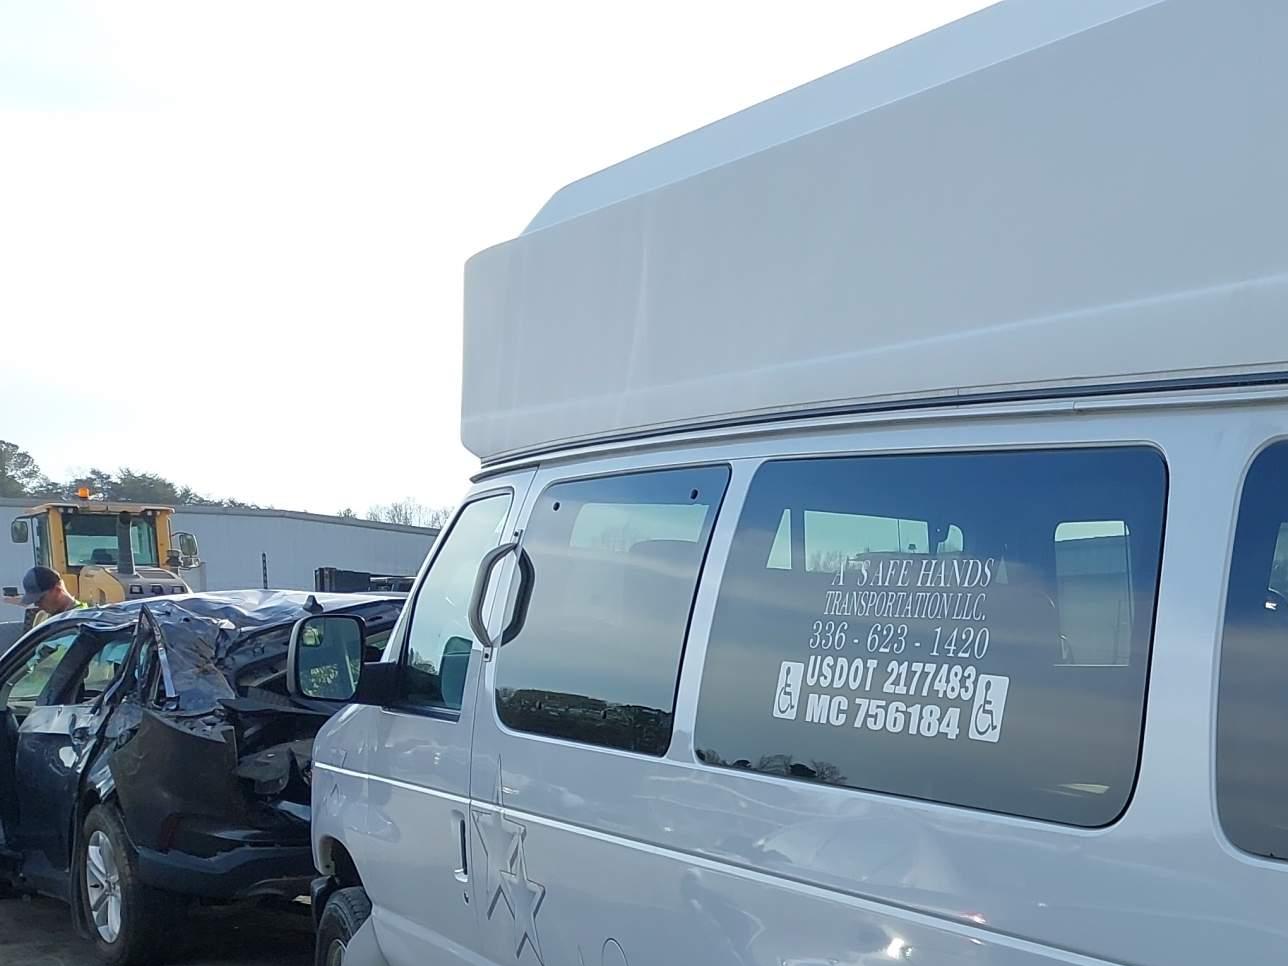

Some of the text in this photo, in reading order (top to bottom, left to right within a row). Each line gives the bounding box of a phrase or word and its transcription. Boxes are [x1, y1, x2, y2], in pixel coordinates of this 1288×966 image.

[831, 558, 994, 588] A SAFE HANDS
[824, 591, 986, 621] TRANSPORTATION LLC.
[809, 620, 848, 650] 336
[866, 623, 908, 654] 623
[930, 626, 990, 659] 1420
[806, 655, 977, 701] USDOT 2177483
[805, 693, 961, 740] MC 756184
